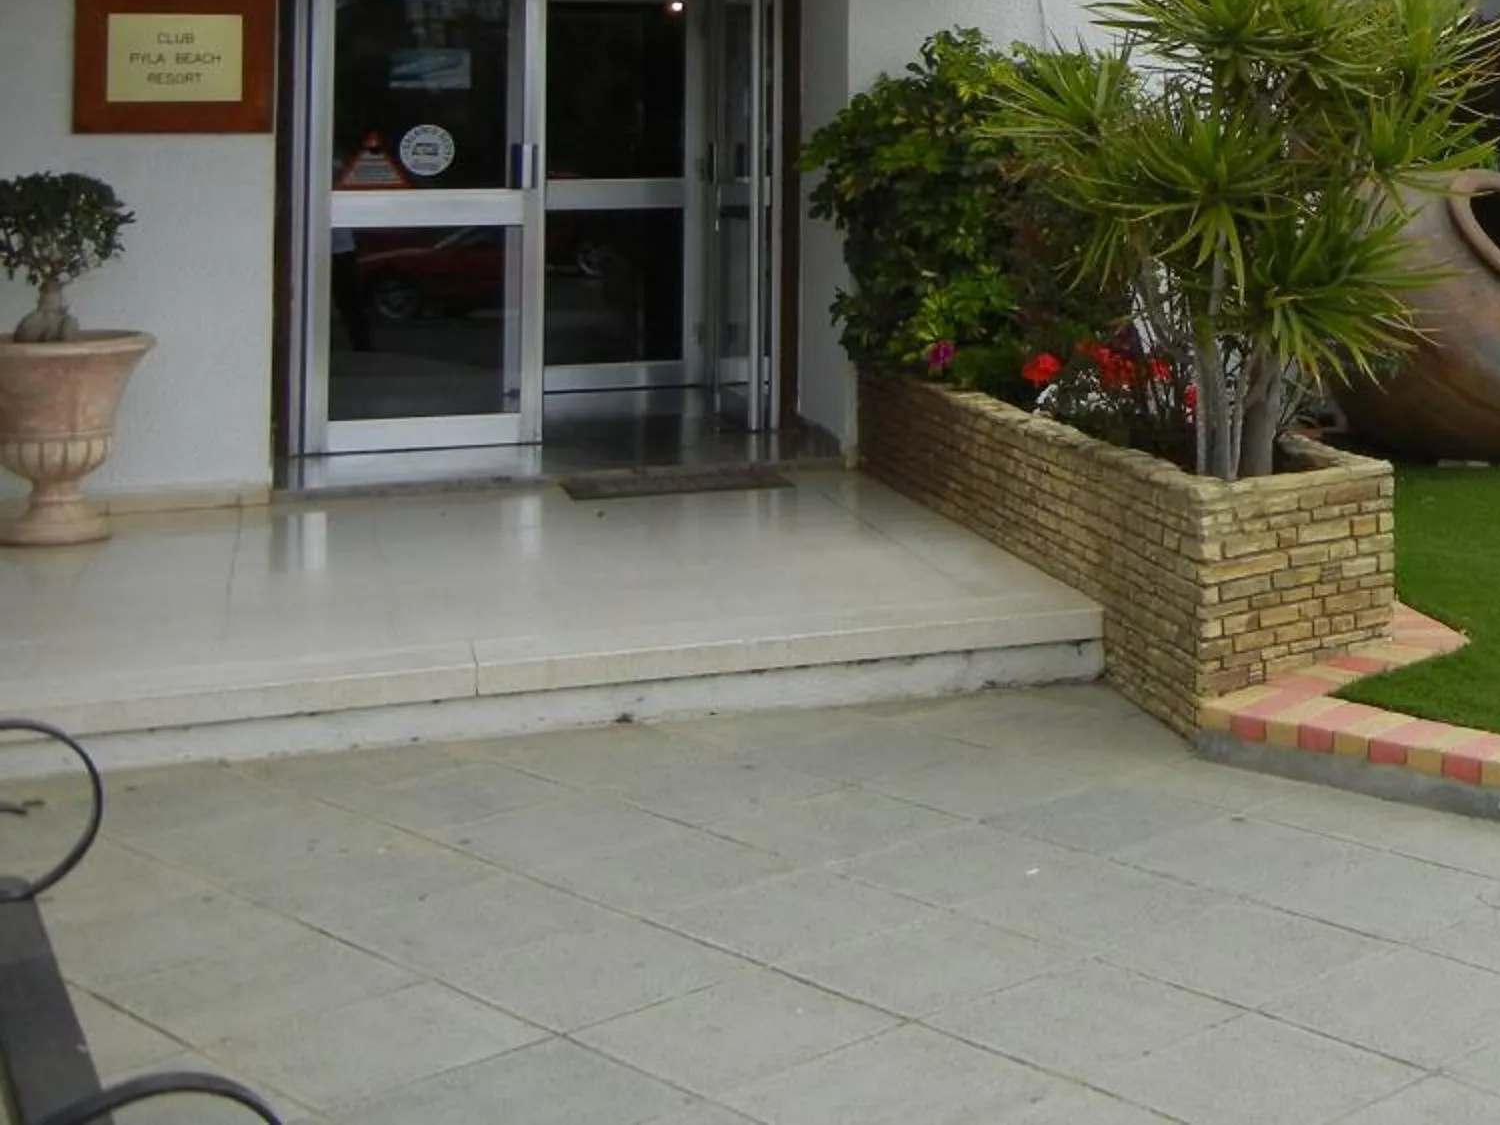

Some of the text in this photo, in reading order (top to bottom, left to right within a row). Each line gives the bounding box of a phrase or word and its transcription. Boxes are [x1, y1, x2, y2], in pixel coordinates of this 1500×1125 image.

[157, 32, 194, 44] CLUB
[129, 52, 221, 65] PYLA BEACH
[147, 72, 203, 85] RESORT
